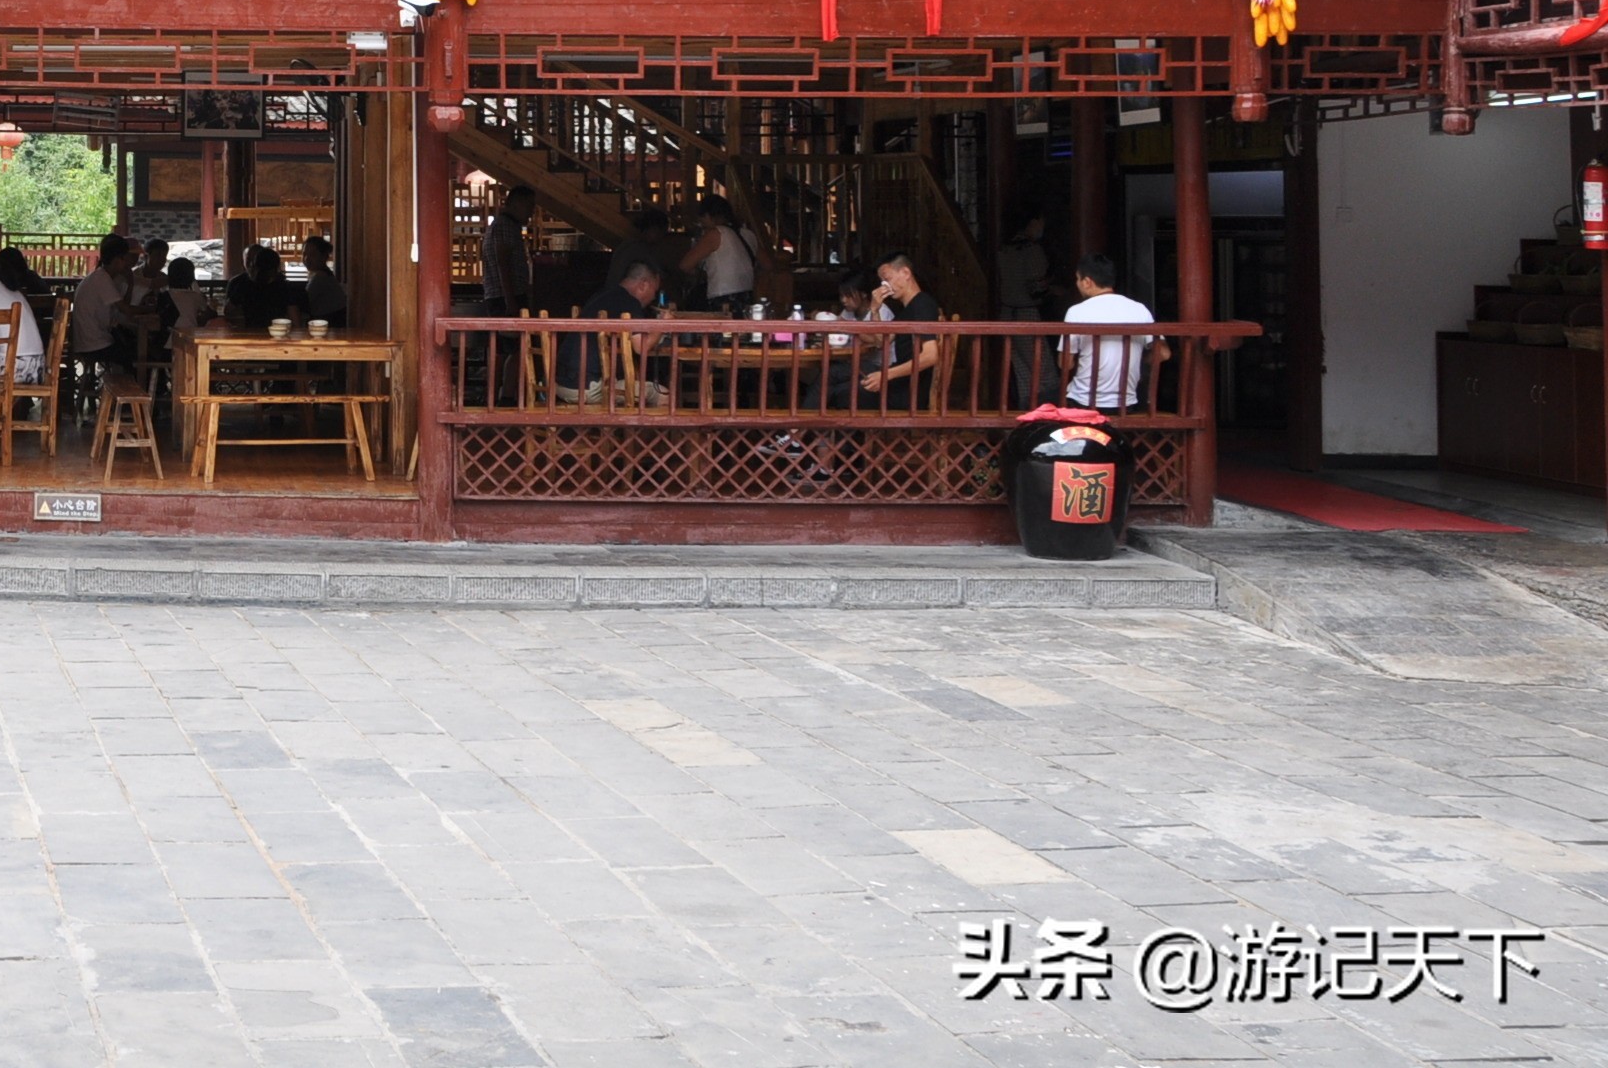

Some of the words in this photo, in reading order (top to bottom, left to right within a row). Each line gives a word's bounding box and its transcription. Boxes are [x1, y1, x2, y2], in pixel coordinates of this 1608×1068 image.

[52, 498, 97, 511] 小心台阶
[1060, 466, 1109, 520] 酒
